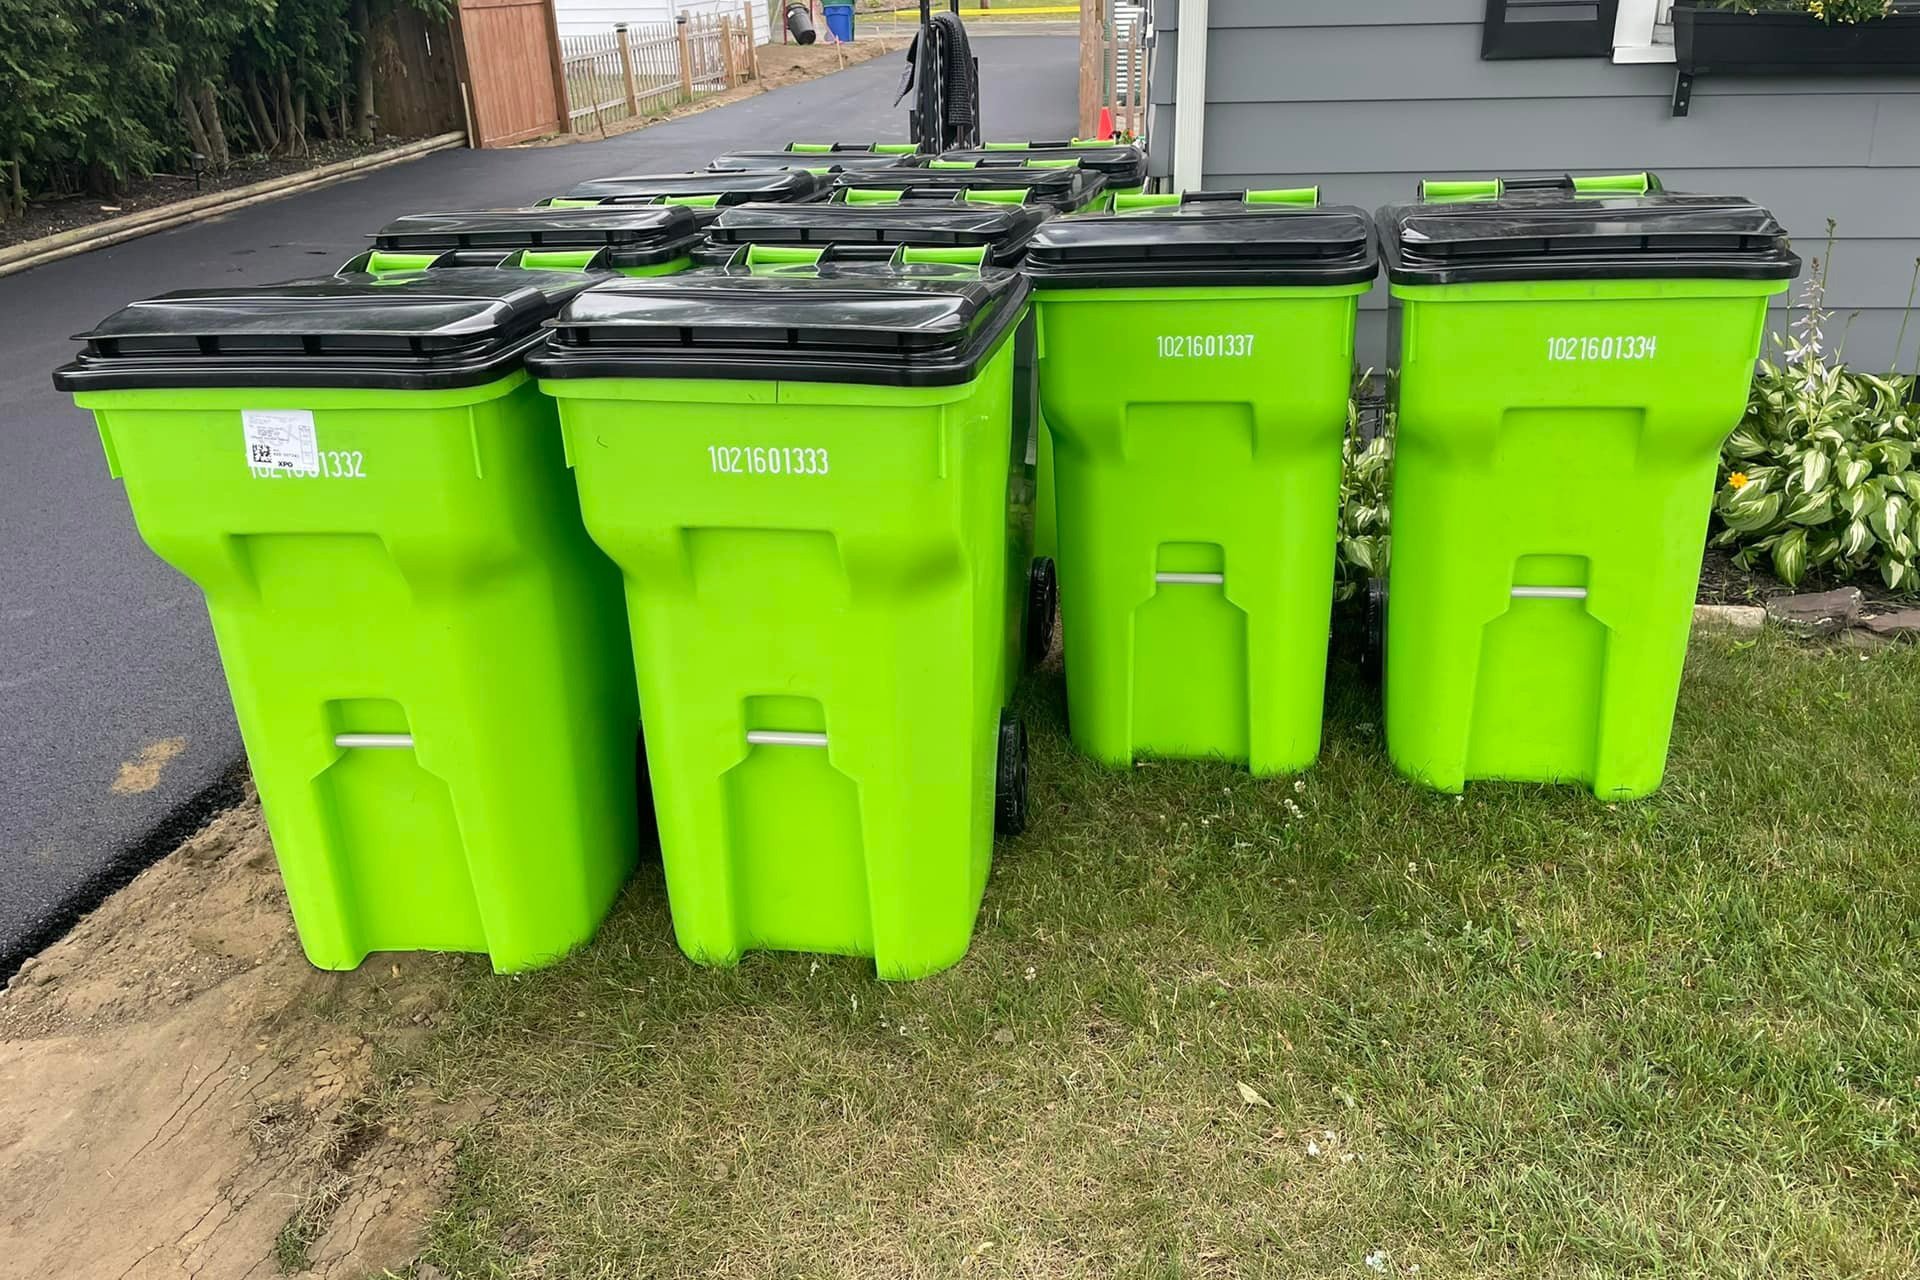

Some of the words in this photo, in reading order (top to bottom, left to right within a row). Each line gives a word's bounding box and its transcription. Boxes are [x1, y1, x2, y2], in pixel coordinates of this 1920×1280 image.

[1157, 334, 1255, 357] 1021601337
[1547, 335, 1657, 361] 1021601334
[707, 445, 829, 475] 1021601333
